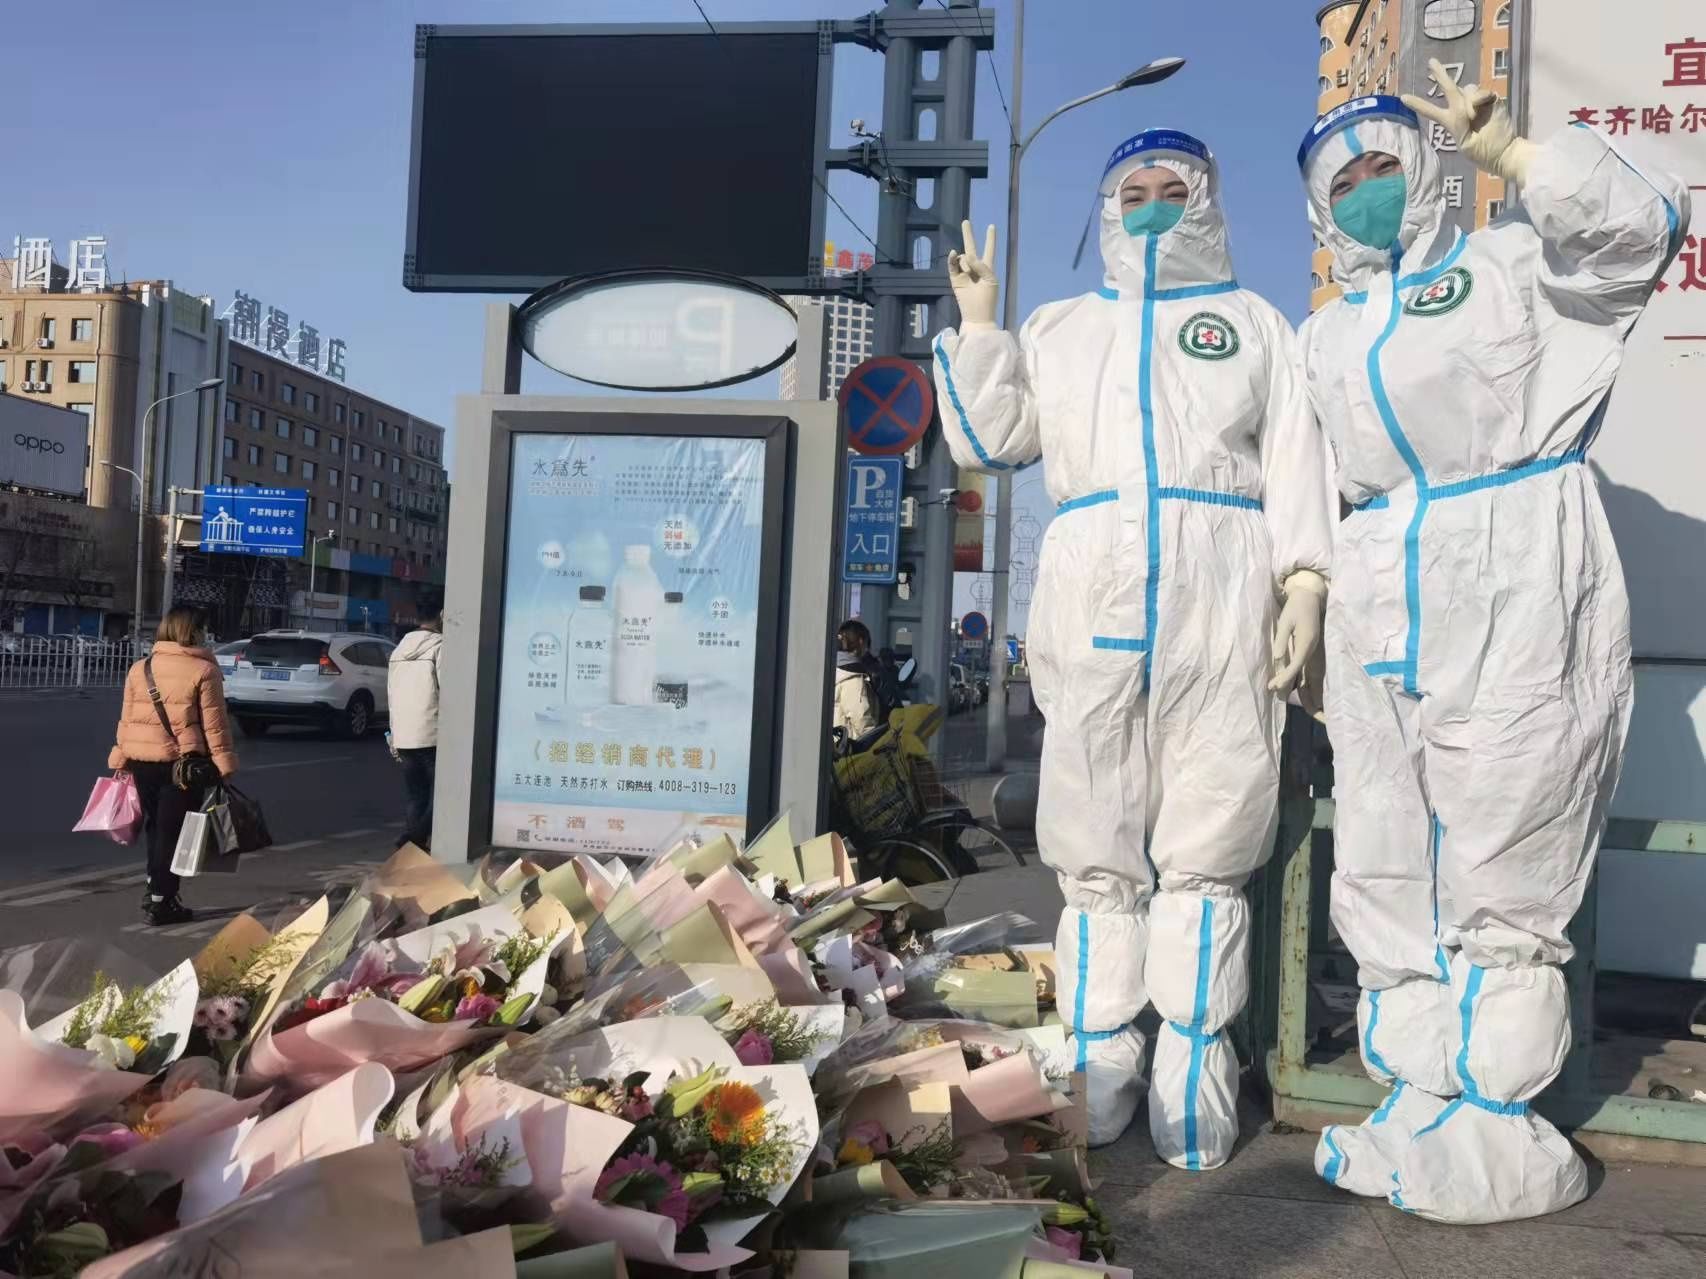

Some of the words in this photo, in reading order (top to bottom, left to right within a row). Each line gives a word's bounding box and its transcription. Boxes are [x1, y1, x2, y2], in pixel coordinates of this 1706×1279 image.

[1663, 37, 1706, 86] 宜
[1568, 103, 1706, 135] 齐齐哈尔
[12, 235, 107, 289] 酒店
[233, 289, 347, 382] 潮漫酒店
[850, 466, 887, 508] P
[851, 533, 890, 554] 入口
[515, 774, 551, 787] 五大连池
[561, 776, 607, 790] 天然苏打水
